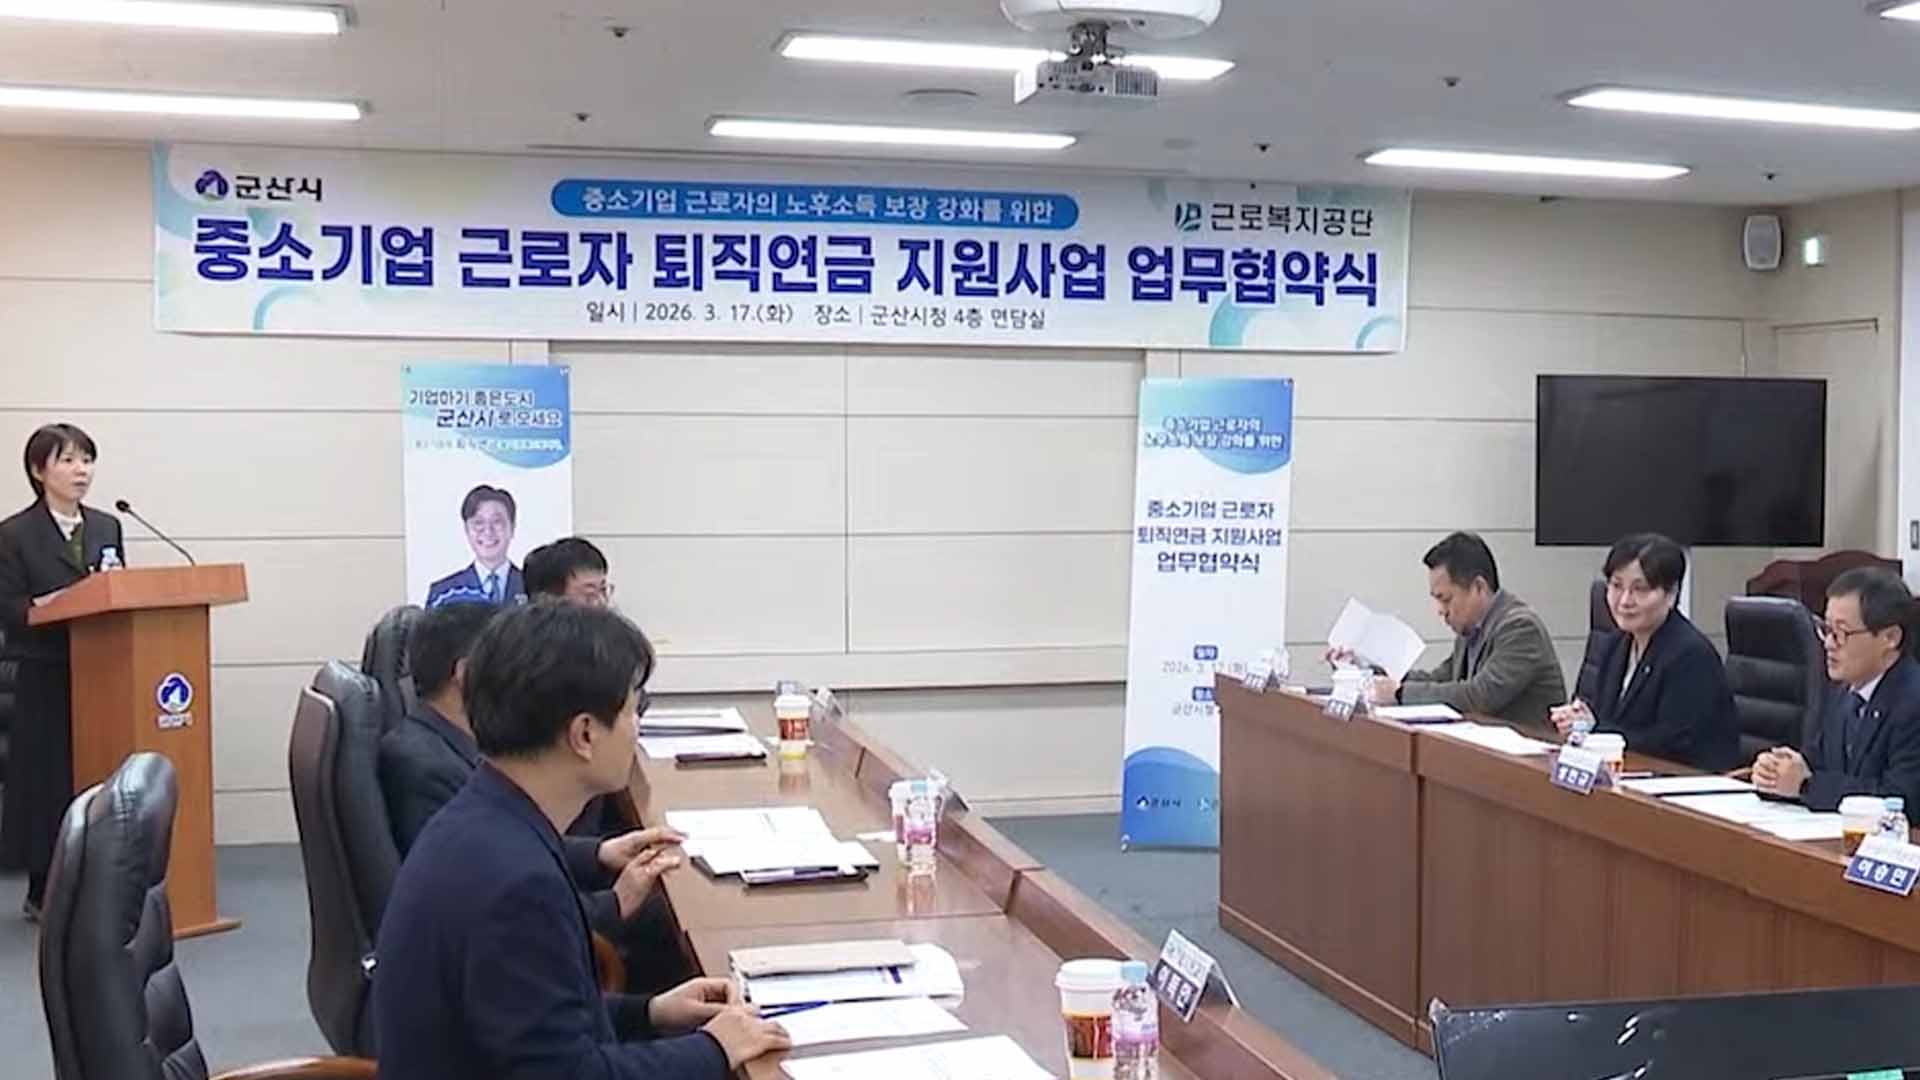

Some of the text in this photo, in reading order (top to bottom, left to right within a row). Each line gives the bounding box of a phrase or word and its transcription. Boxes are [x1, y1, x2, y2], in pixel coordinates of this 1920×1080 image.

[235, 175, 322, 202] 군산시
[582, 187, 1053, 224] 중소기업 근로자의 노후소득 보장 강화를 위한
[1211, 203, 1373, 237] 근로복지공단
[194, 218, 1377, 307] 중소기업 근로자 퇴직연금 지원사업 업무협약식
[587, 302, 1046, 329] 일시 2026. 3. 17.(화) 장소 군산시청 4층 면담실
[410, 389, 469, 406] 기업하기
[1147, 500, 1275, 520] 중소기업 근로자
[1137, 526, 1282, 546] 퇴직연금 지원사업
[1157, 551, 1260, 574] 업무협약식
